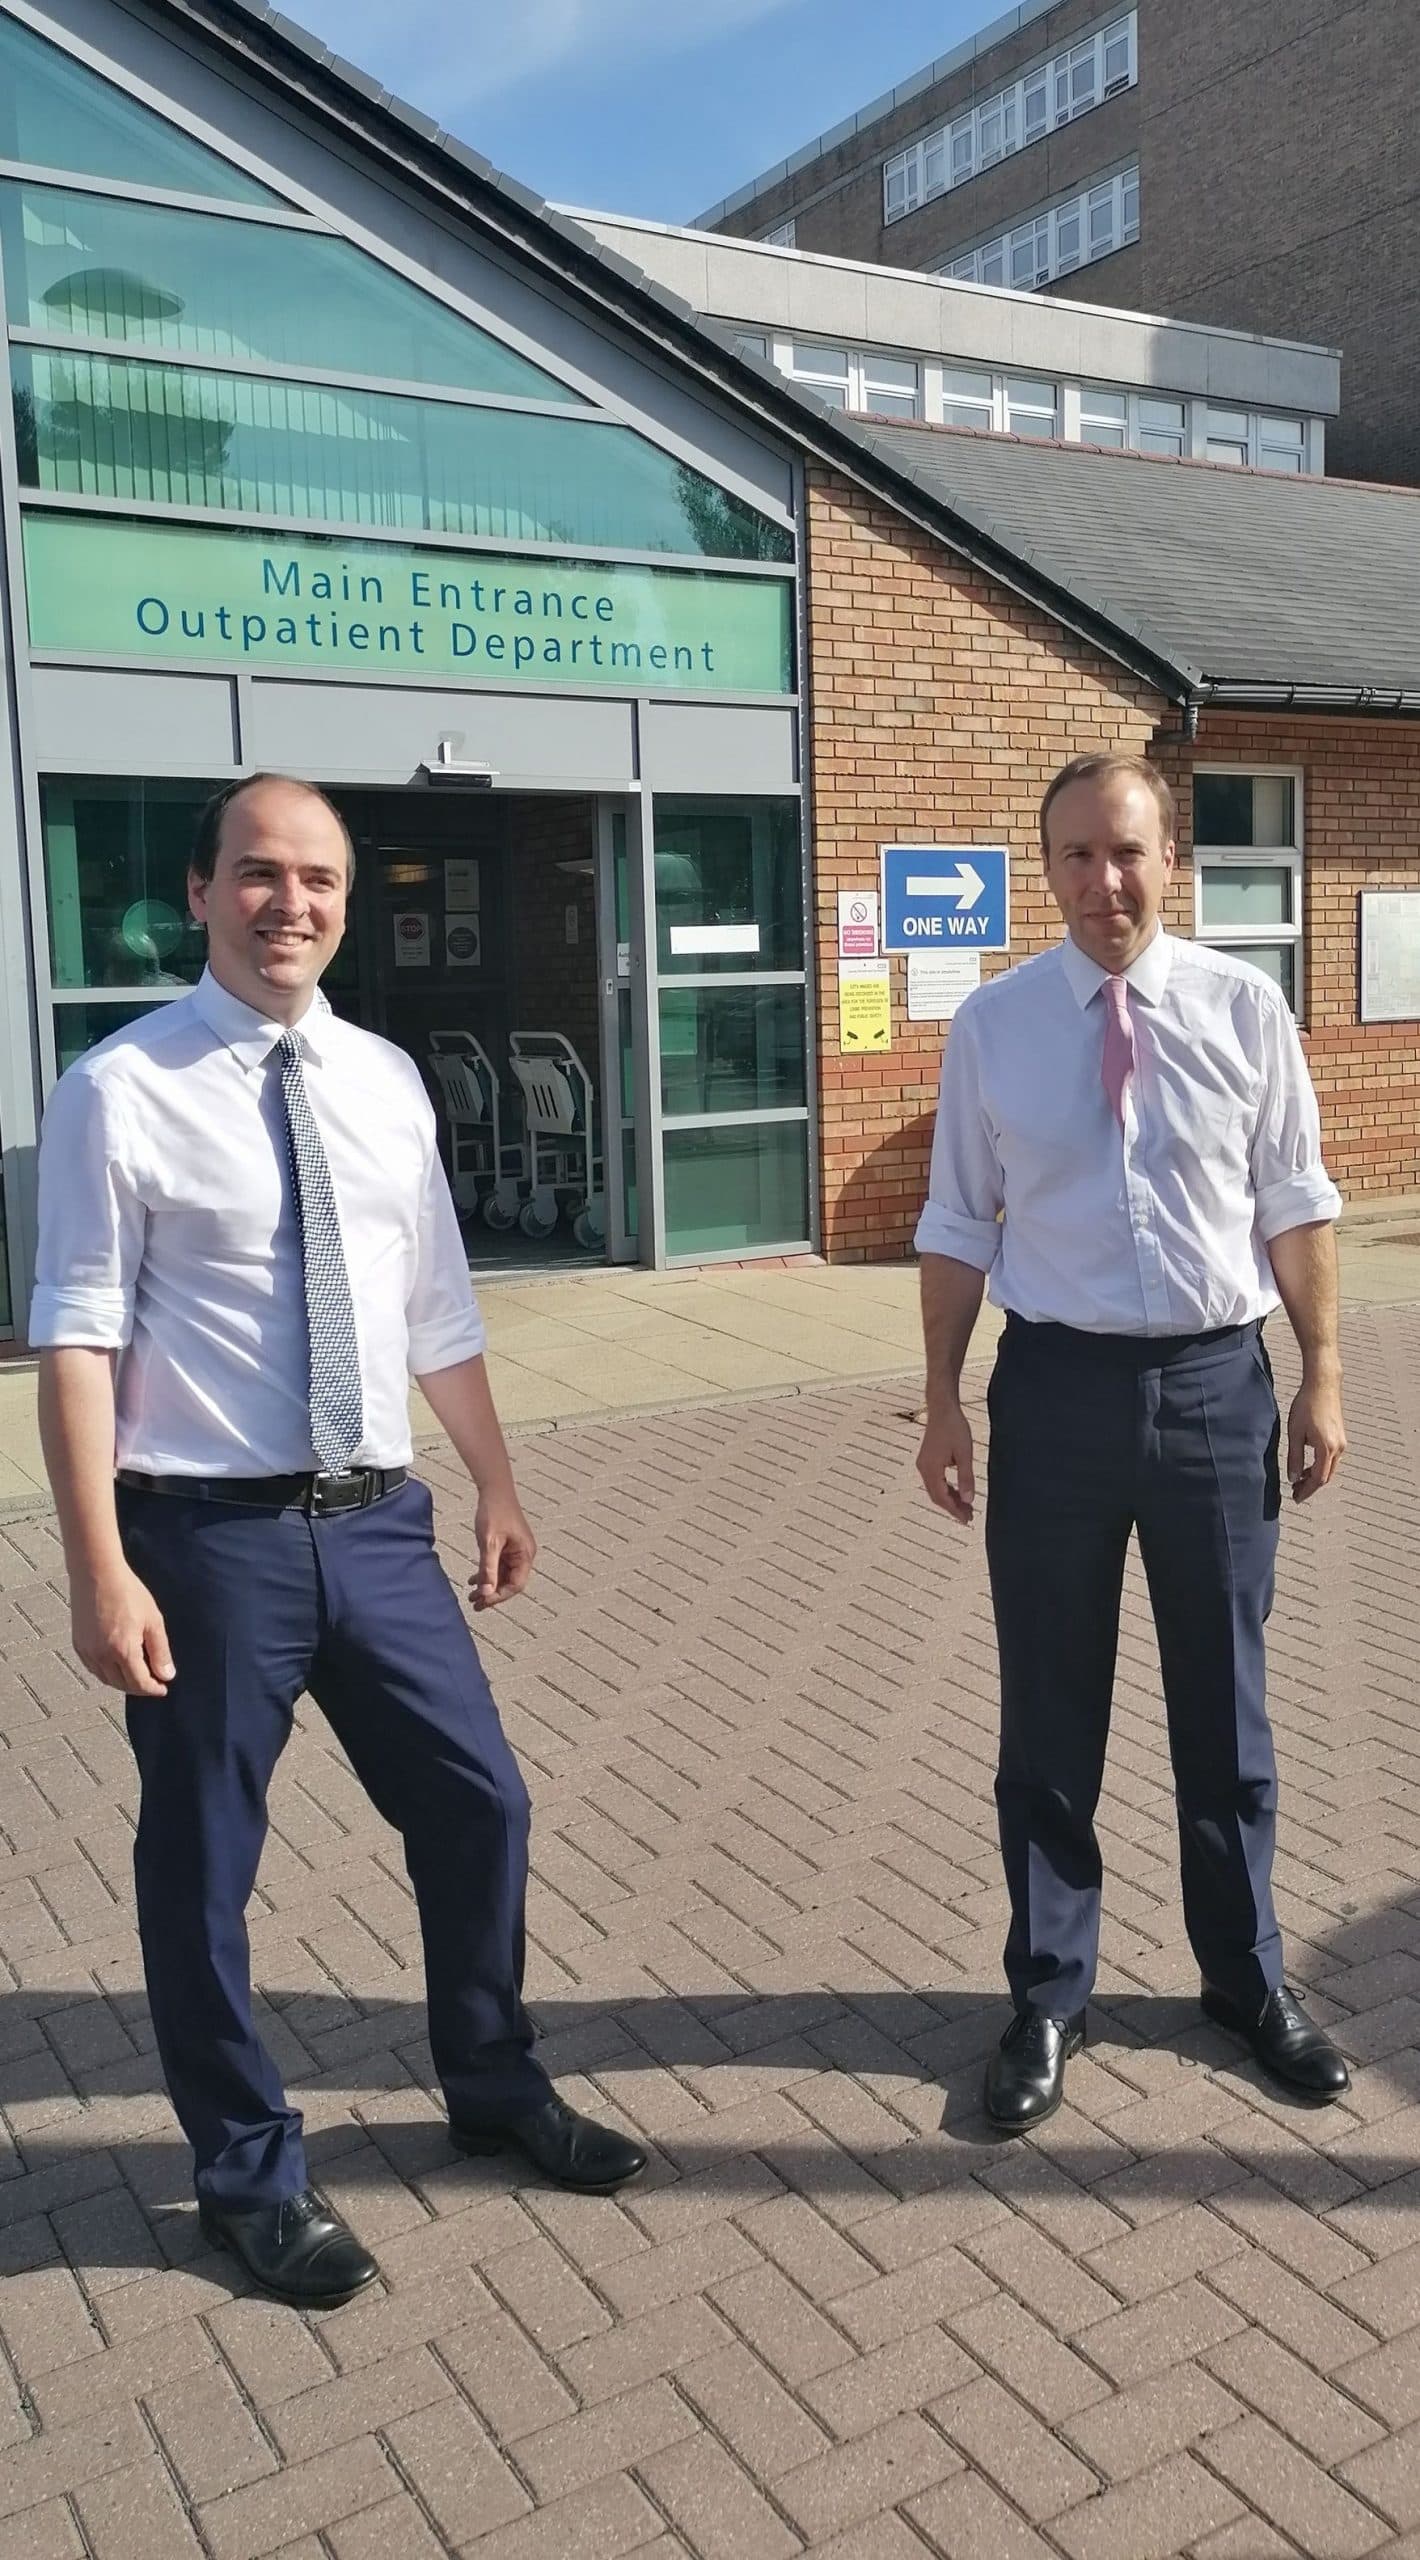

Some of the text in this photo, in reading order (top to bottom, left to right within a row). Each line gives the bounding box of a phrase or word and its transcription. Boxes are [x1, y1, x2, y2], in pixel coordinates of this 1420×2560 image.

[263, 558, 614, 622] Main Entrance
[136, 597, 715, 672] Outpatient Department
[902, 916, 990, 936] ONE WAY
